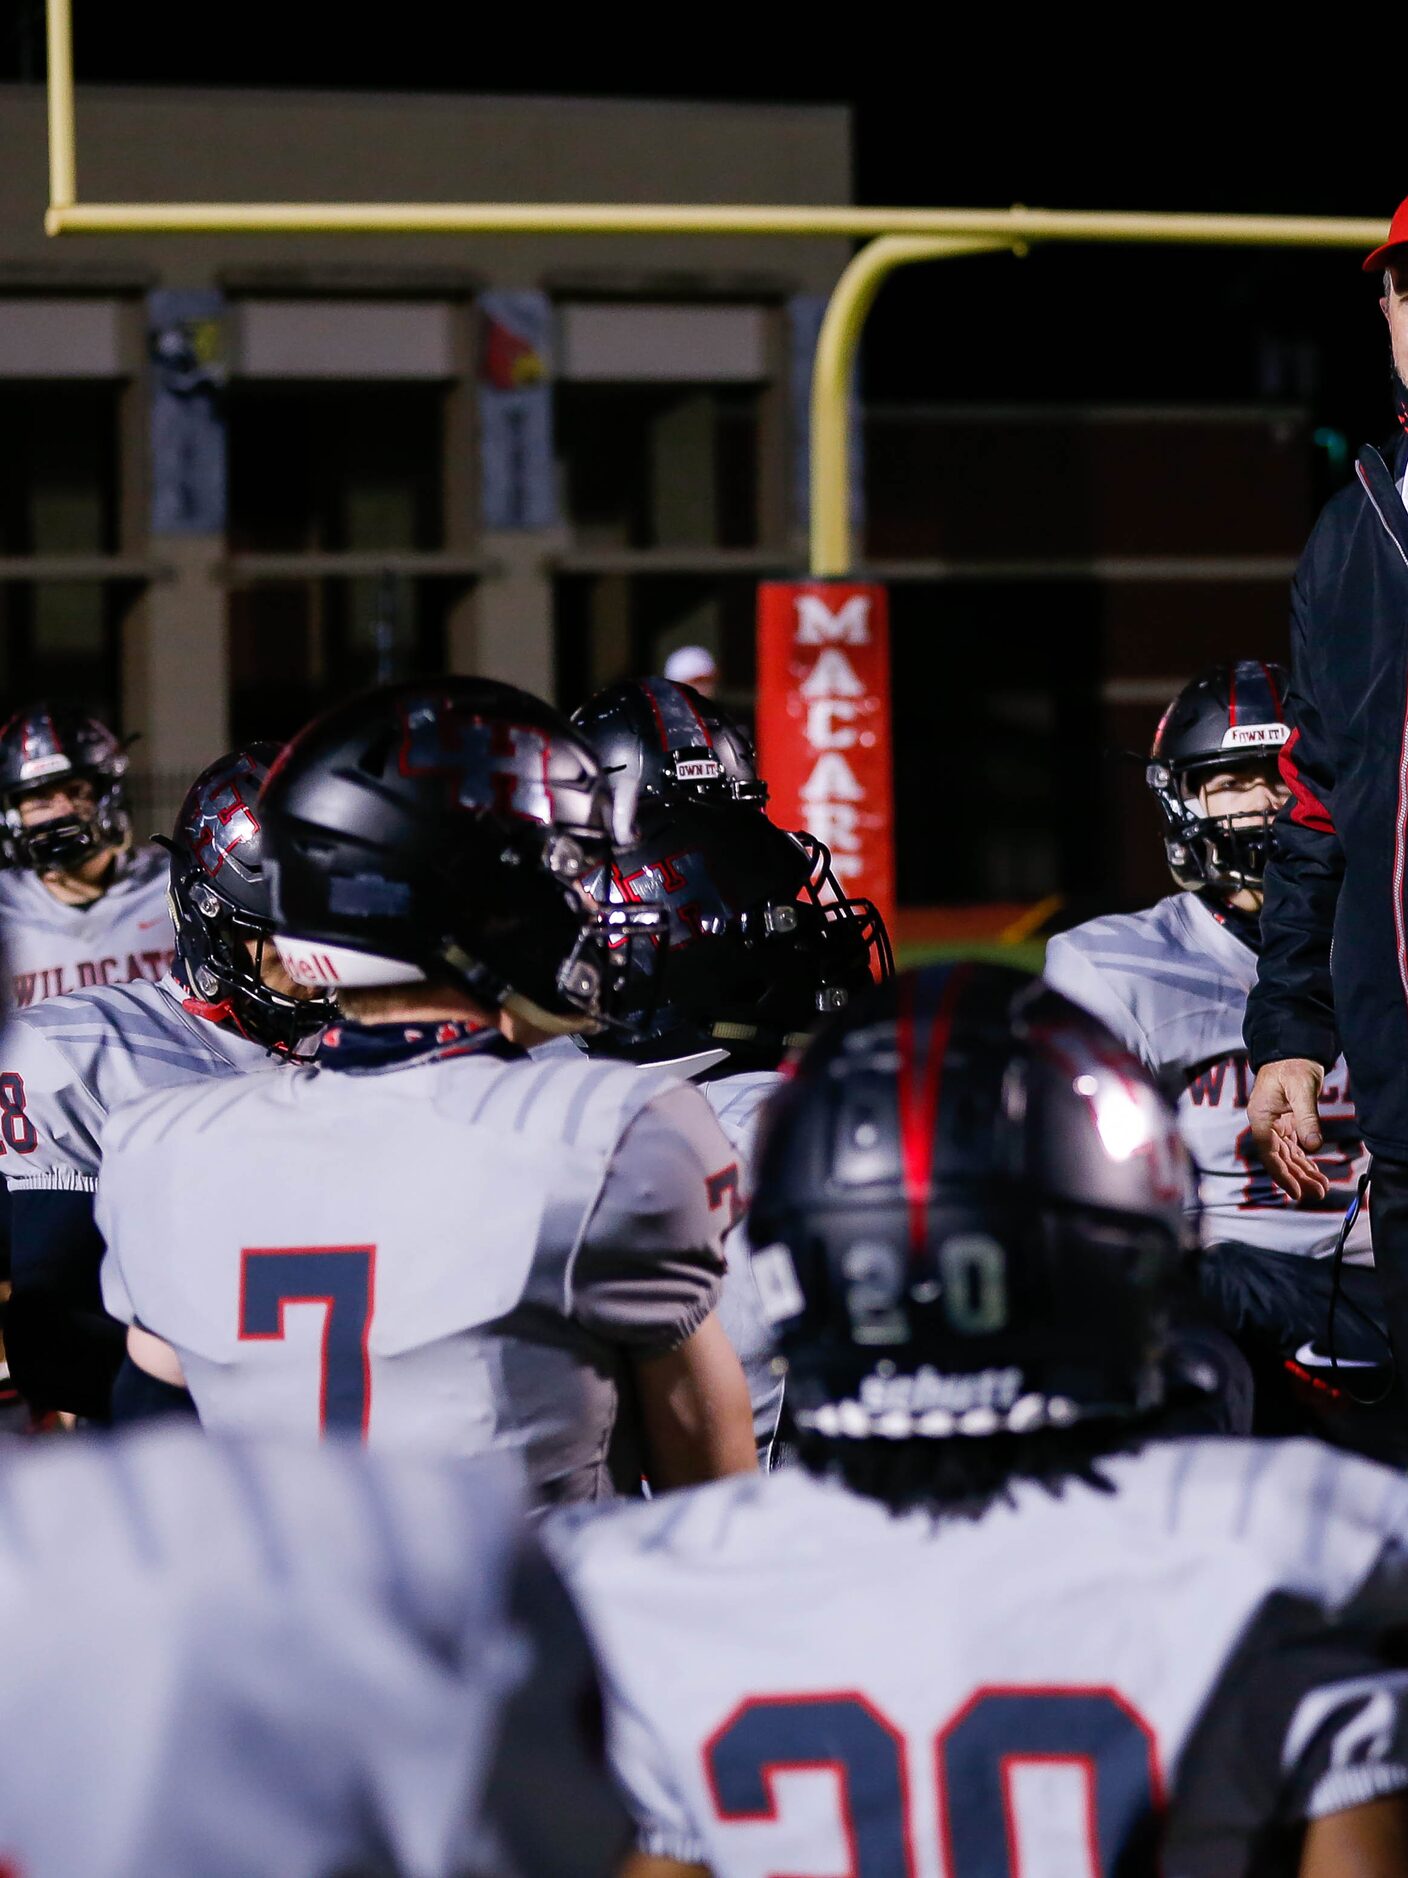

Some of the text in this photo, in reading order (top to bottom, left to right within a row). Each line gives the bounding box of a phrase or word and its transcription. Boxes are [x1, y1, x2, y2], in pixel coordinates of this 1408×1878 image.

[679, 764, 716, 777] OWN IT
[842, 1236, 1007, 1344] 20
[238, 1245, 377, 1448] 7
